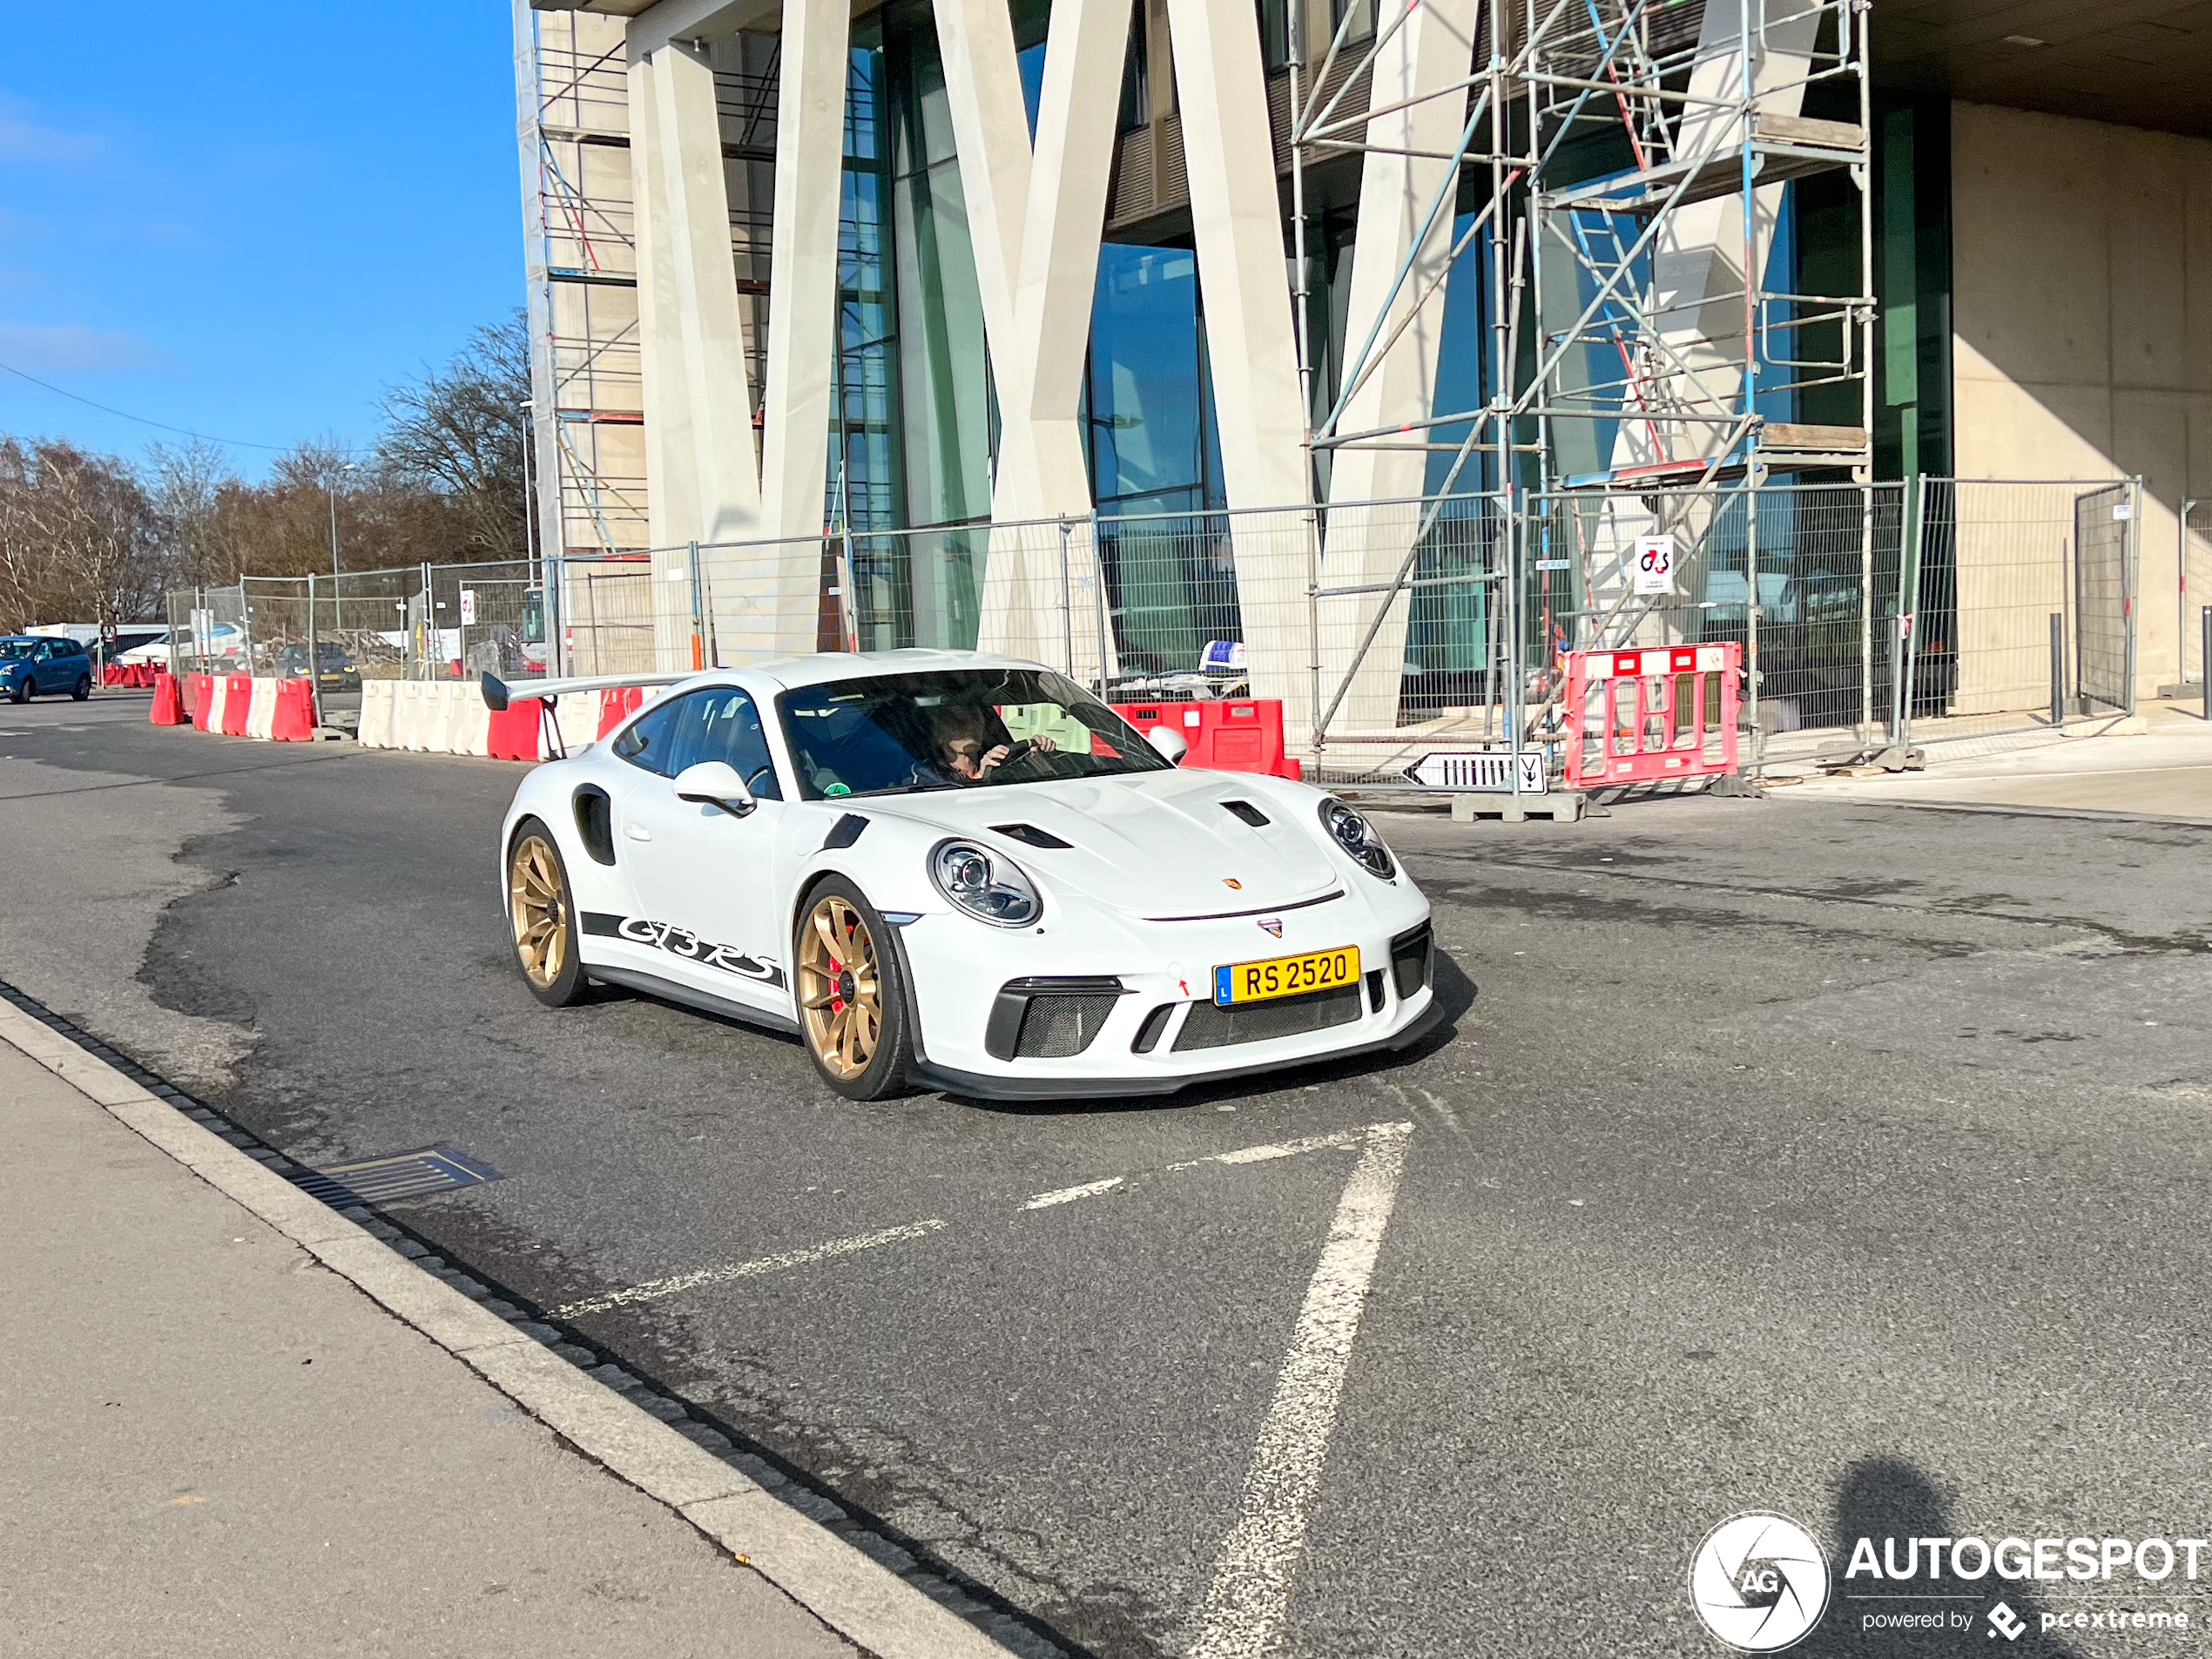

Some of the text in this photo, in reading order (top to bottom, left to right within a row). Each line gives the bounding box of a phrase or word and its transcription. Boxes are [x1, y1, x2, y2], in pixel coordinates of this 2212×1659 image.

[617, 916, 778, 980] GT3 RS
[1246, 965, 1279, 996] RS
[1286, 954, 1347, 990] 2520
